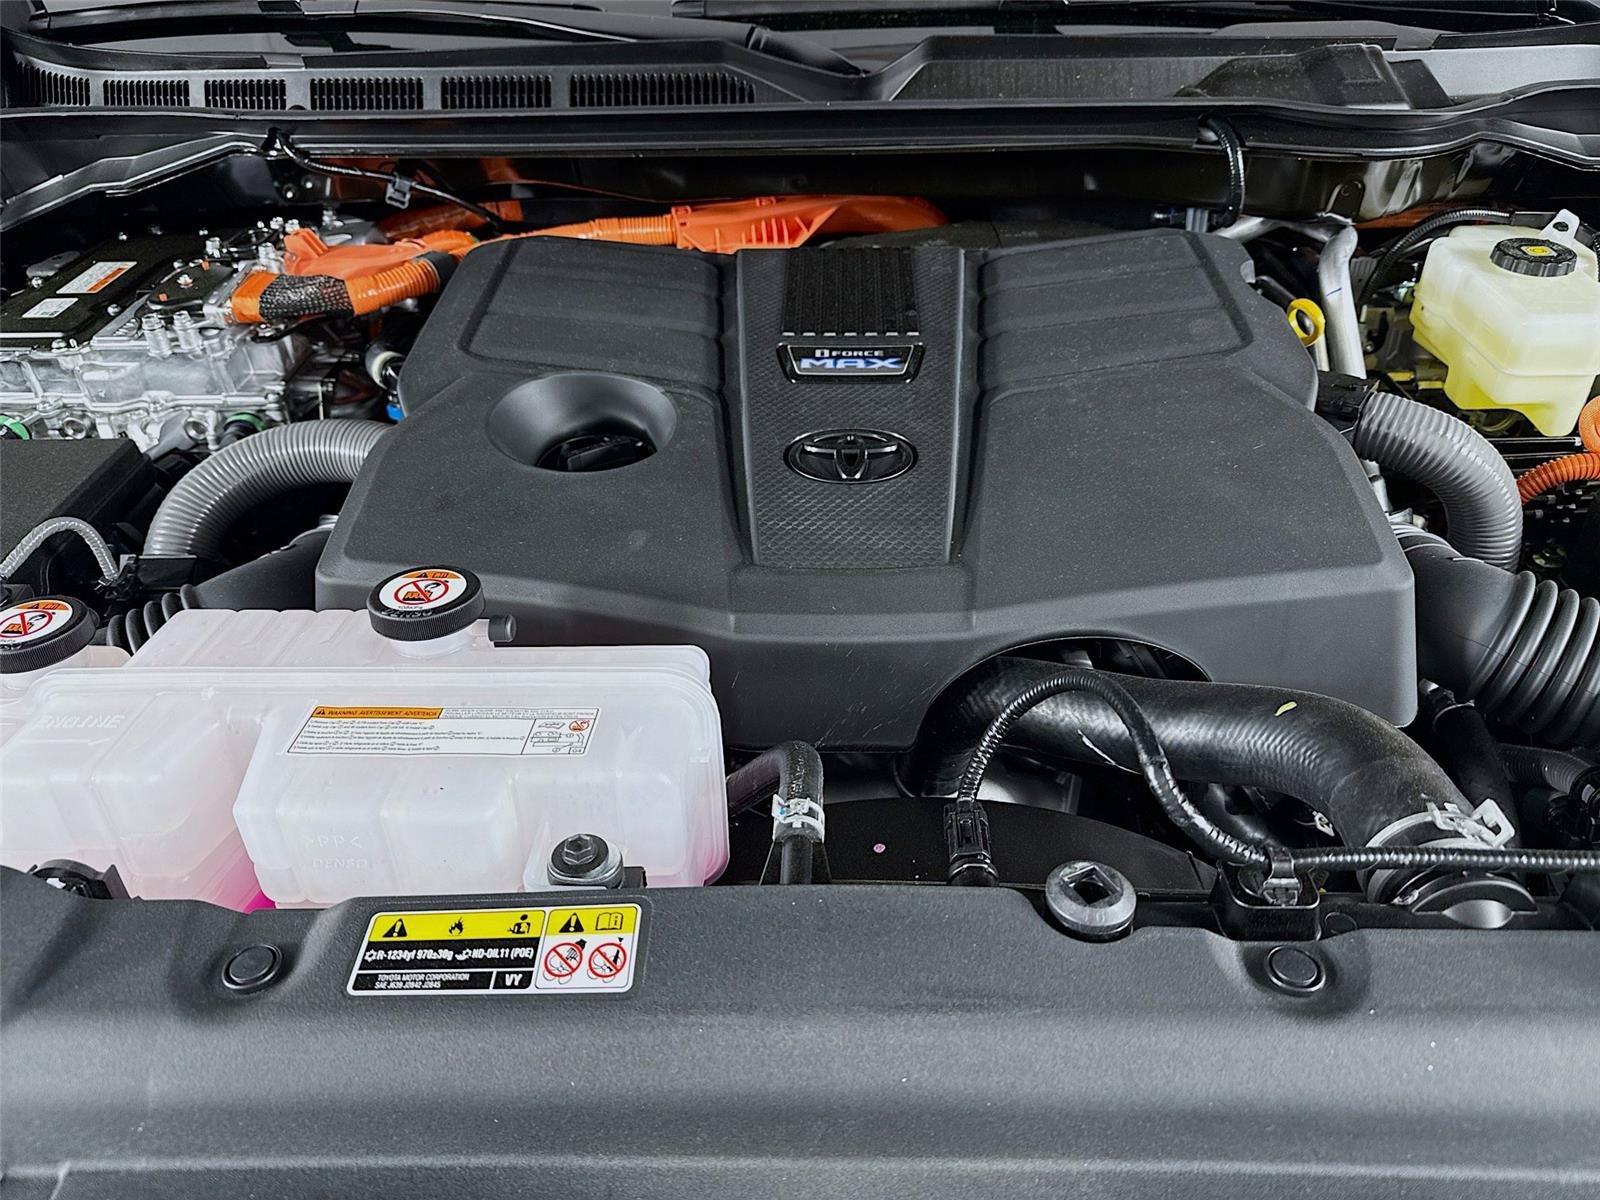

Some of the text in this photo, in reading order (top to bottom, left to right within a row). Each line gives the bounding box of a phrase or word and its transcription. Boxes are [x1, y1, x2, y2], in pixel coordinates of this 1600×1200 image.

[801, 358, 902, 369] MAX
[510, 947, 534, 960] (POE)
[402, 973, 425, 981] MOTOR
[426, 973, 470, 981] CORPORATION
[505, 973, 523, 986] VY
[374, 981, 388, 989] SAE
